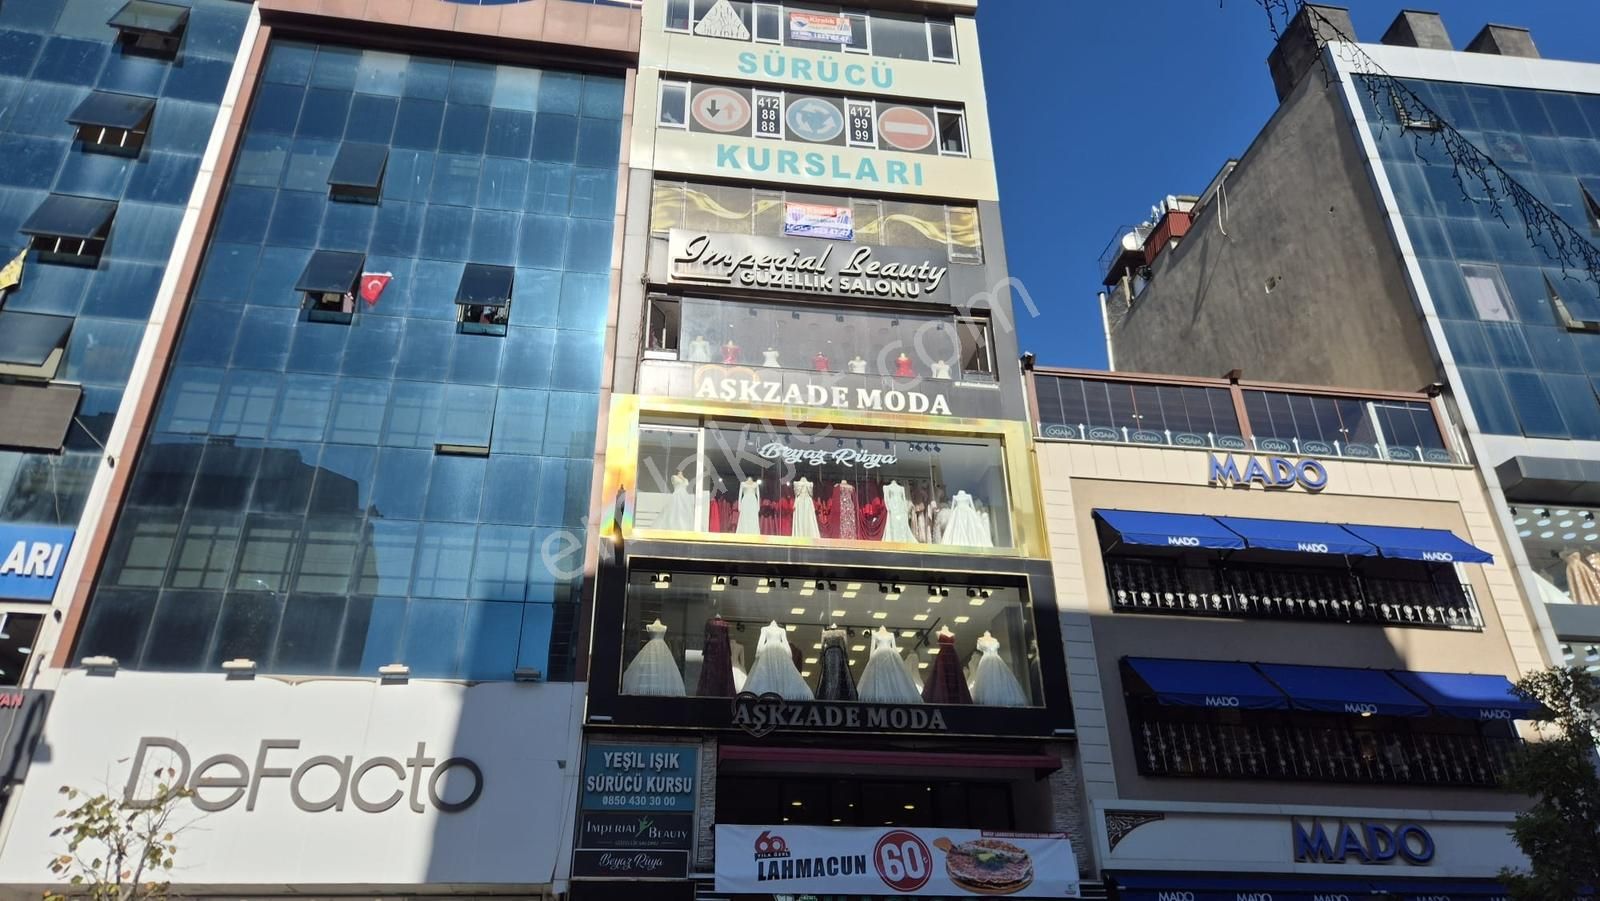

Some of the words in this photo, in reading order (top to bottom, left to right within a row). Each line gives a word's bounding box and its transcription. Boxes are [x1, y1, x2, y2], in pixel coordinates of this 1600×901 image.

[737, 49, 894, 90] SÜRÜCÜ
[757, 98, 779, 110] 412
[850, 105, 871, 118] 412
[762, 108, 776, 121] 88
[761, 121, 776, 133] 88
[854, 118, 869, 130] 99
[855, 130, 869, 142] 99
[716, 143, 924, 186] KURSLARI
[674, 234, 834, 284] Imperial
[839, 245, 948, 294] Beauty
[738, 267, 833, 292] GÜZELLİK
[839, 276, 922, 298] SALONU
[695, 376, 849, 411] AŞKZADE
[856, 388, 953, 416] MODA
[759, 442, 829, 467] Beyaz
[832, 448, 899, 469] Rüya
[1209, 450, 1328, 493] MADO
[1168, 535, 1199, 548] MADO
[1298, 542, 1329, 554] MADO
[0, 540, 64, 578] ARI
[1423, 551, 1454, 563] MADO
[1205, 695, 1239, 707] MADO
[1345, 703, 1378, 714] MADO
[732, 704, 862, 729] AŞKZADE
[866, 707, 947, 730] MODA
[1480, 709, 1511, 720] MADO
[603, 752, 646, 772] YEŞİL
[650, 752, 680, 772] IŞIK
[119, 735, 485, 814] DeFacto
[646, 776, 692, 793] KURSU
[602, 795, 626, 806] 0850
[628, 796, 647, 806] 430
[649, 796, 661, 806] 30
[664, 796, 676, 806] 00
[1292, 816, 1435, 866] MADO
[599, 852, 632, 870] Beyaz
[757, 854, 867, 882] LAHMACUN
